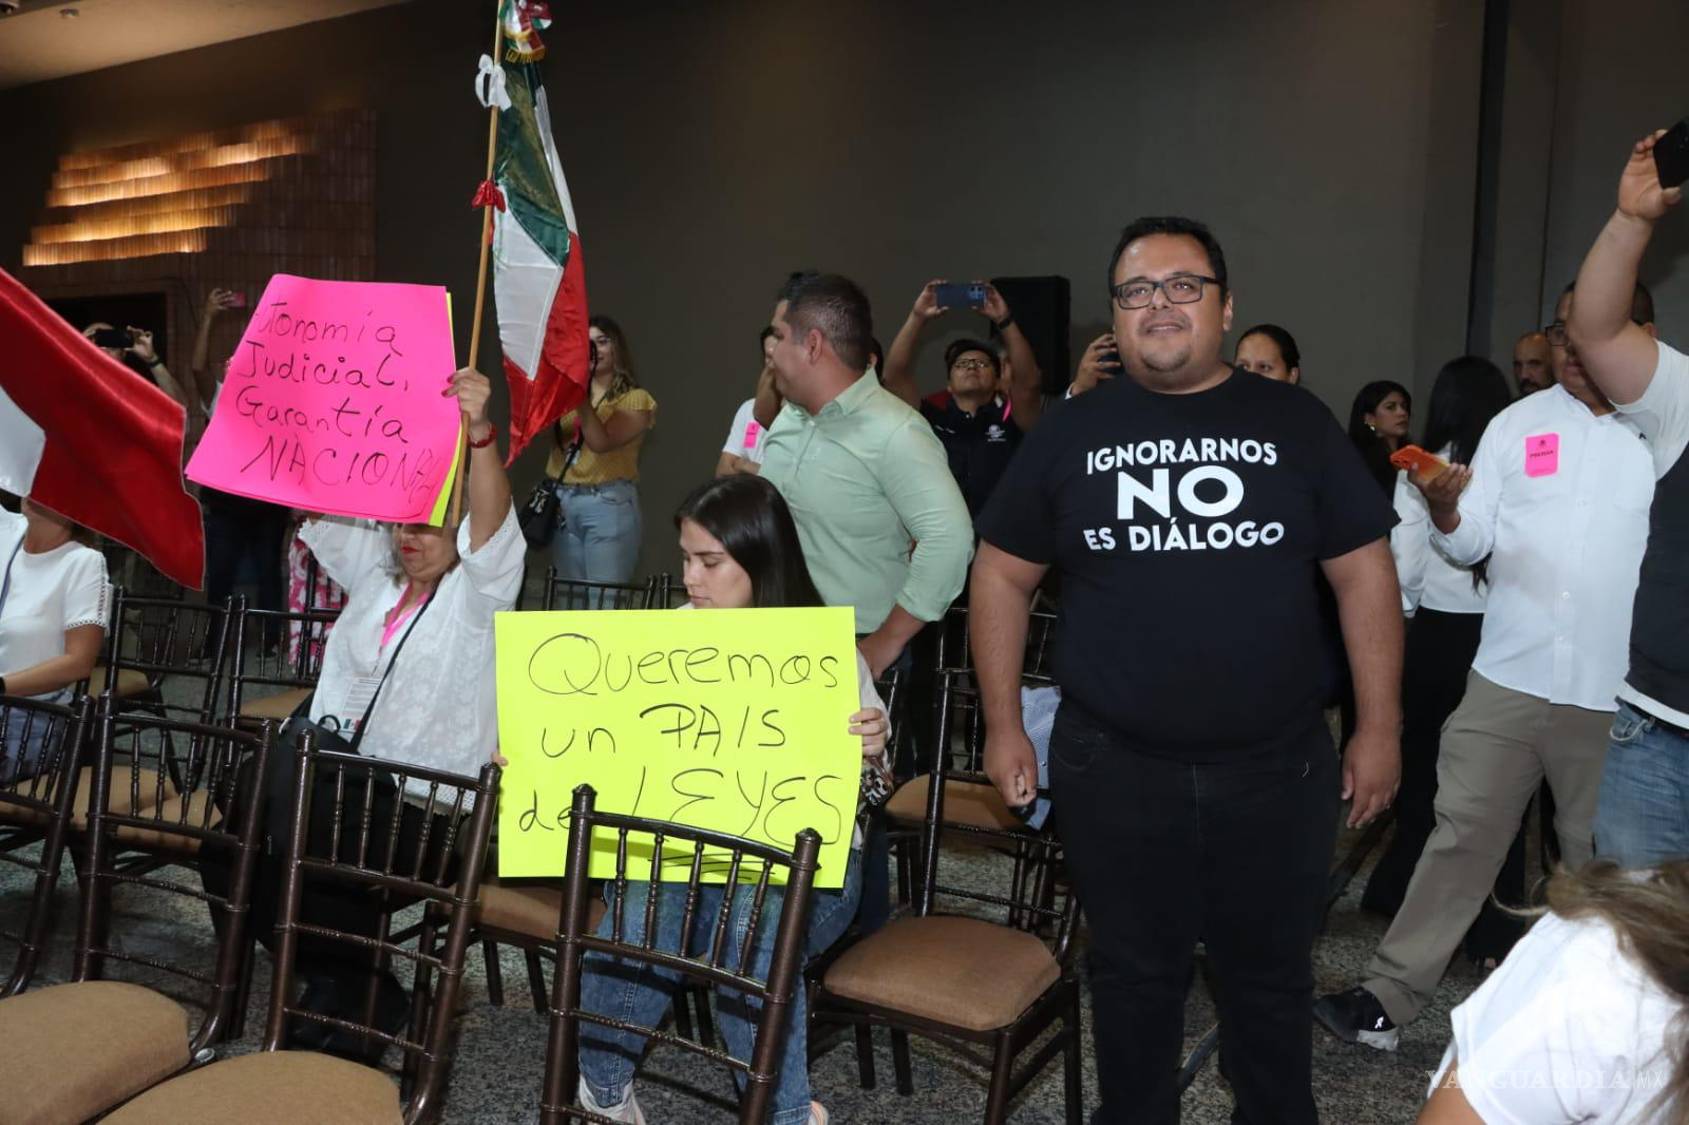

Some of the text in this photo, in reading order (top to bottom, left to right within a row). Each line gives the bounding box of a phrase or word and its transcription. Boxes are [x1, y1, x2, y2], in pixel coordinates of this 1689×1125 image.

[235, 386, 408, 443] Garantía
[1086, 437, 1278, 475] IGNORARNOS
[1116, 465, 1245, 520] NO
[1083, 517, 1285, 551] ES DIÁLOGO
[528, 633, 839, 696] Queremos
[541, 702, 786, 759] un PAIS
